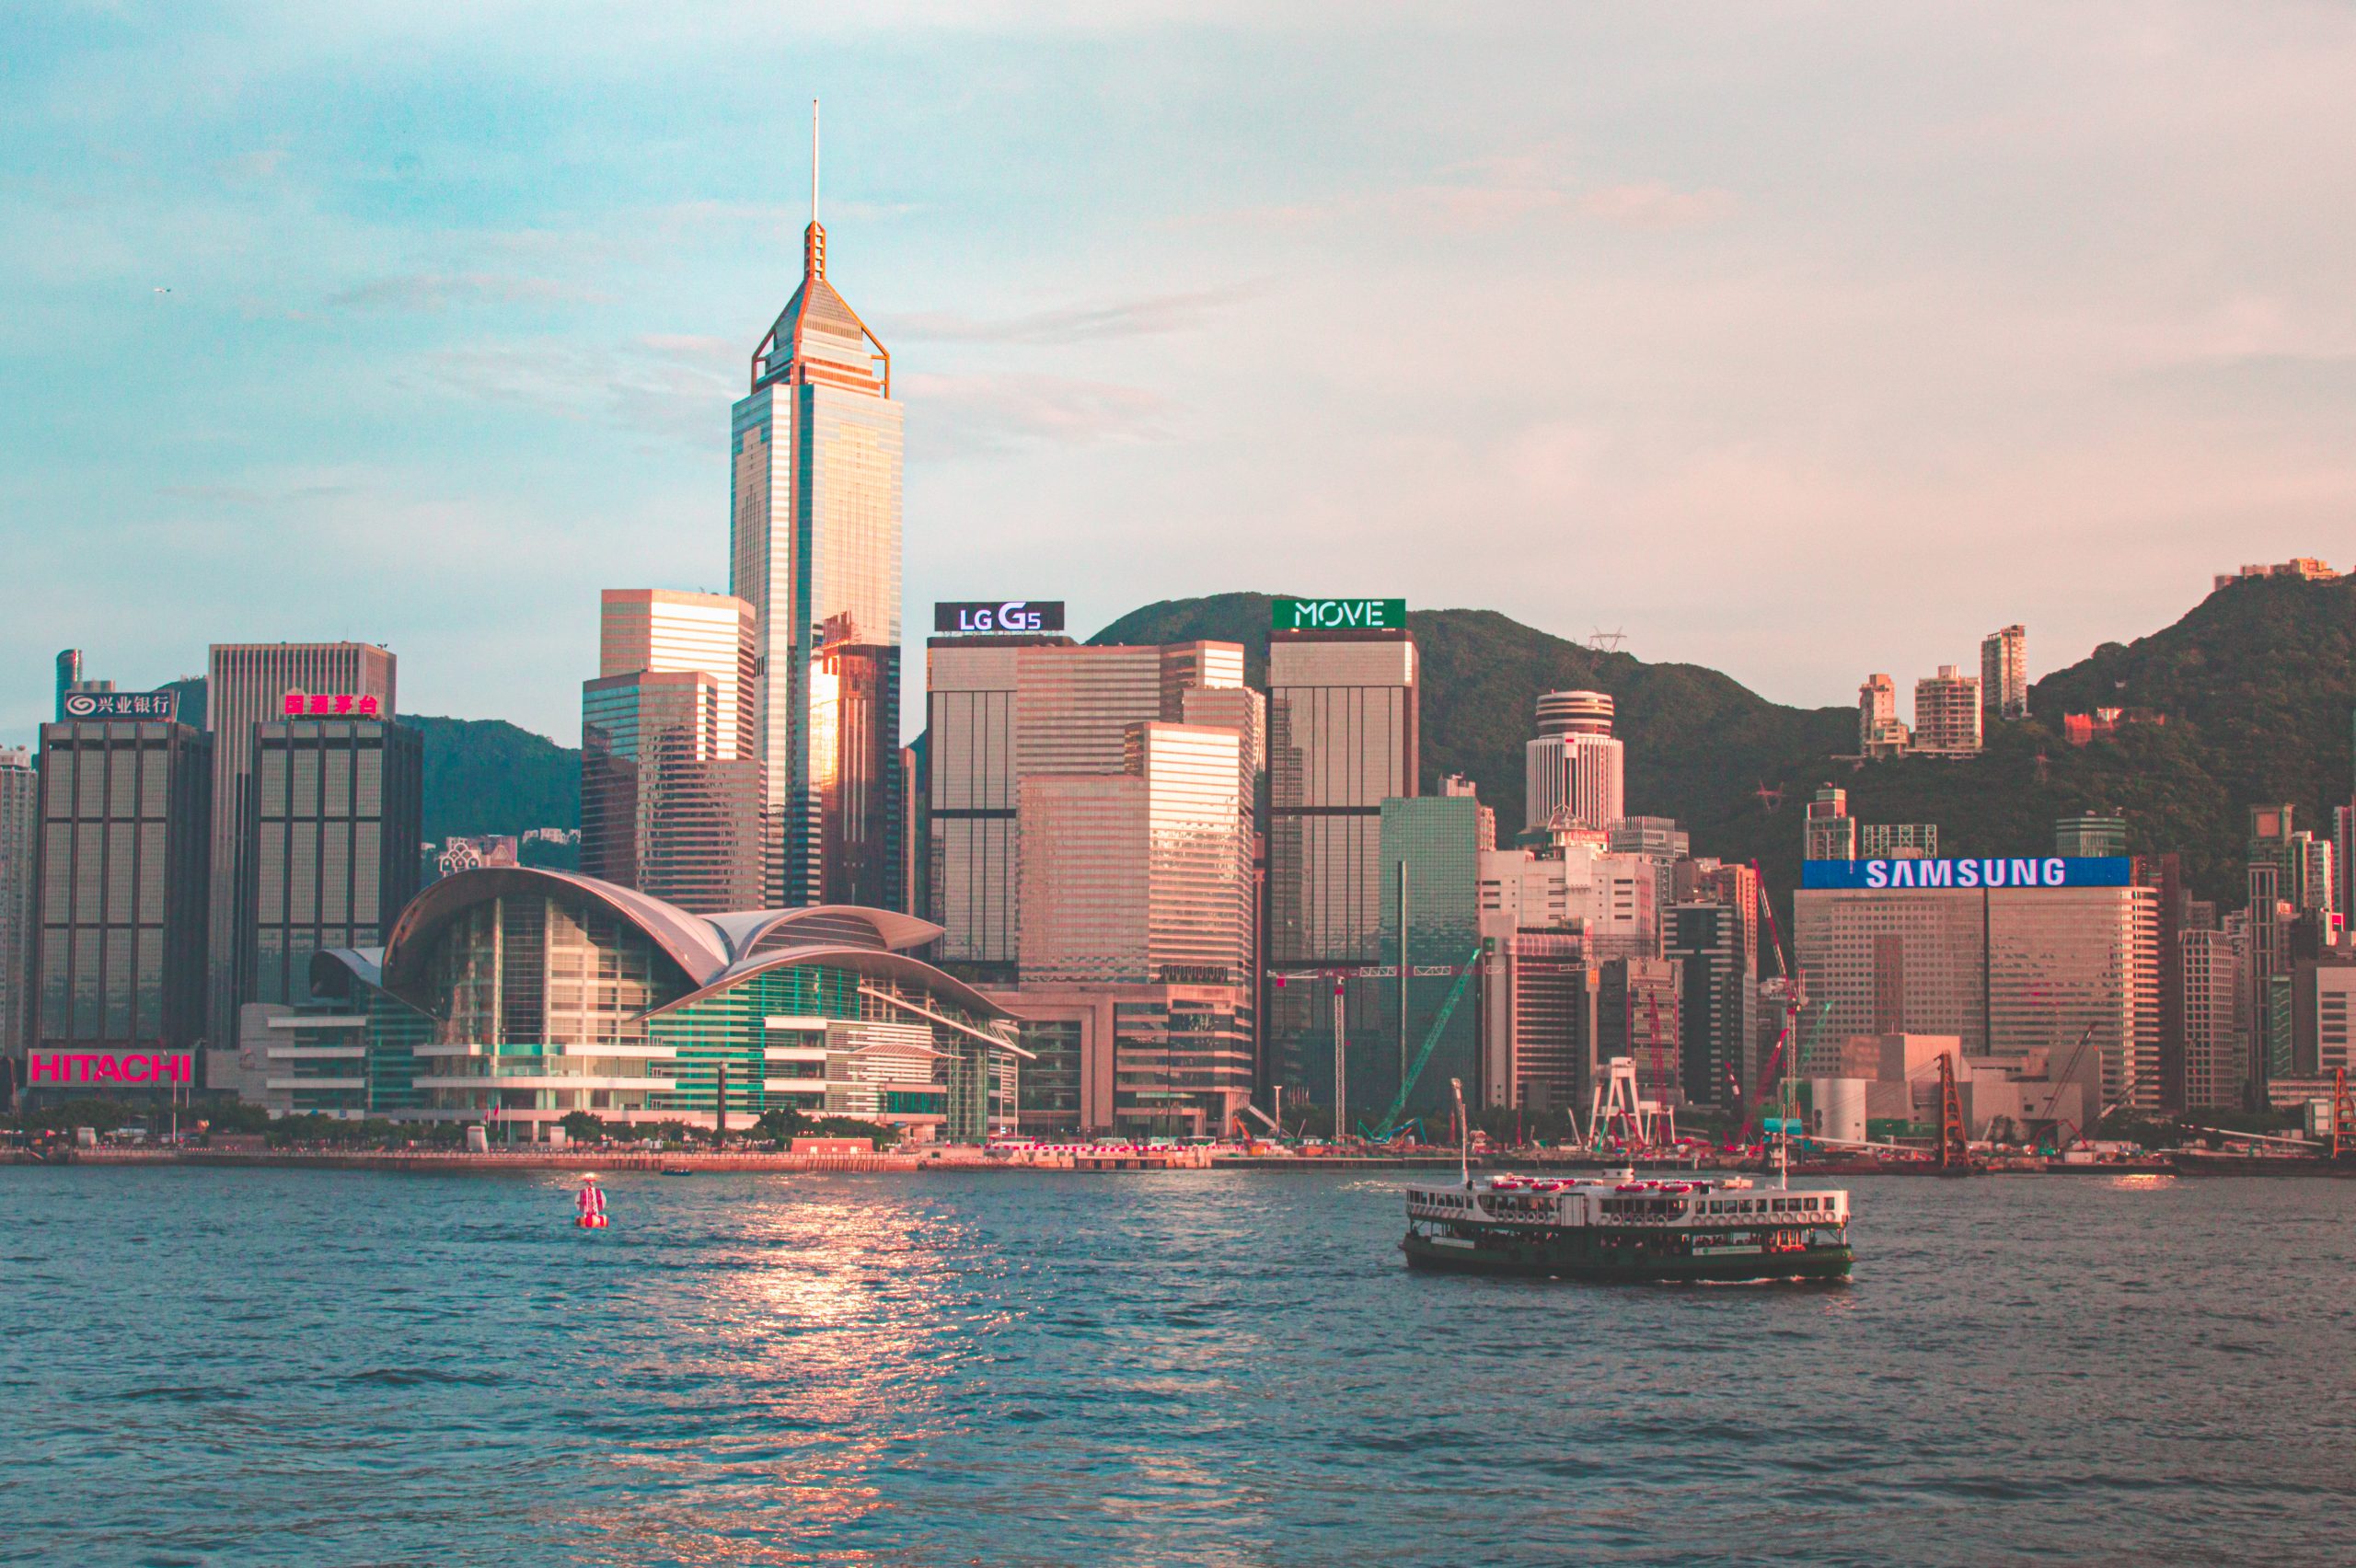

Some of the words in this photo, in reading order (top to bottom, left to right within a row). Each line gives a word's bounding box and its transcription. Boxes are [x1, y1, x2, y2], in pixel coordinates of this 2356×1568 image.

[960, 609, 992, 630] LG
[999, 602, 1041, 630] G5
[1295, 601, 1384, 627] MOVE
[97, 696, 169, 714] 兴业银行
[284, 694, 377, 715] 国酒茅台
[1866, 858, 2066, 888] SAMSUNG
[31, 1055, 191, 1082] HITACHI
